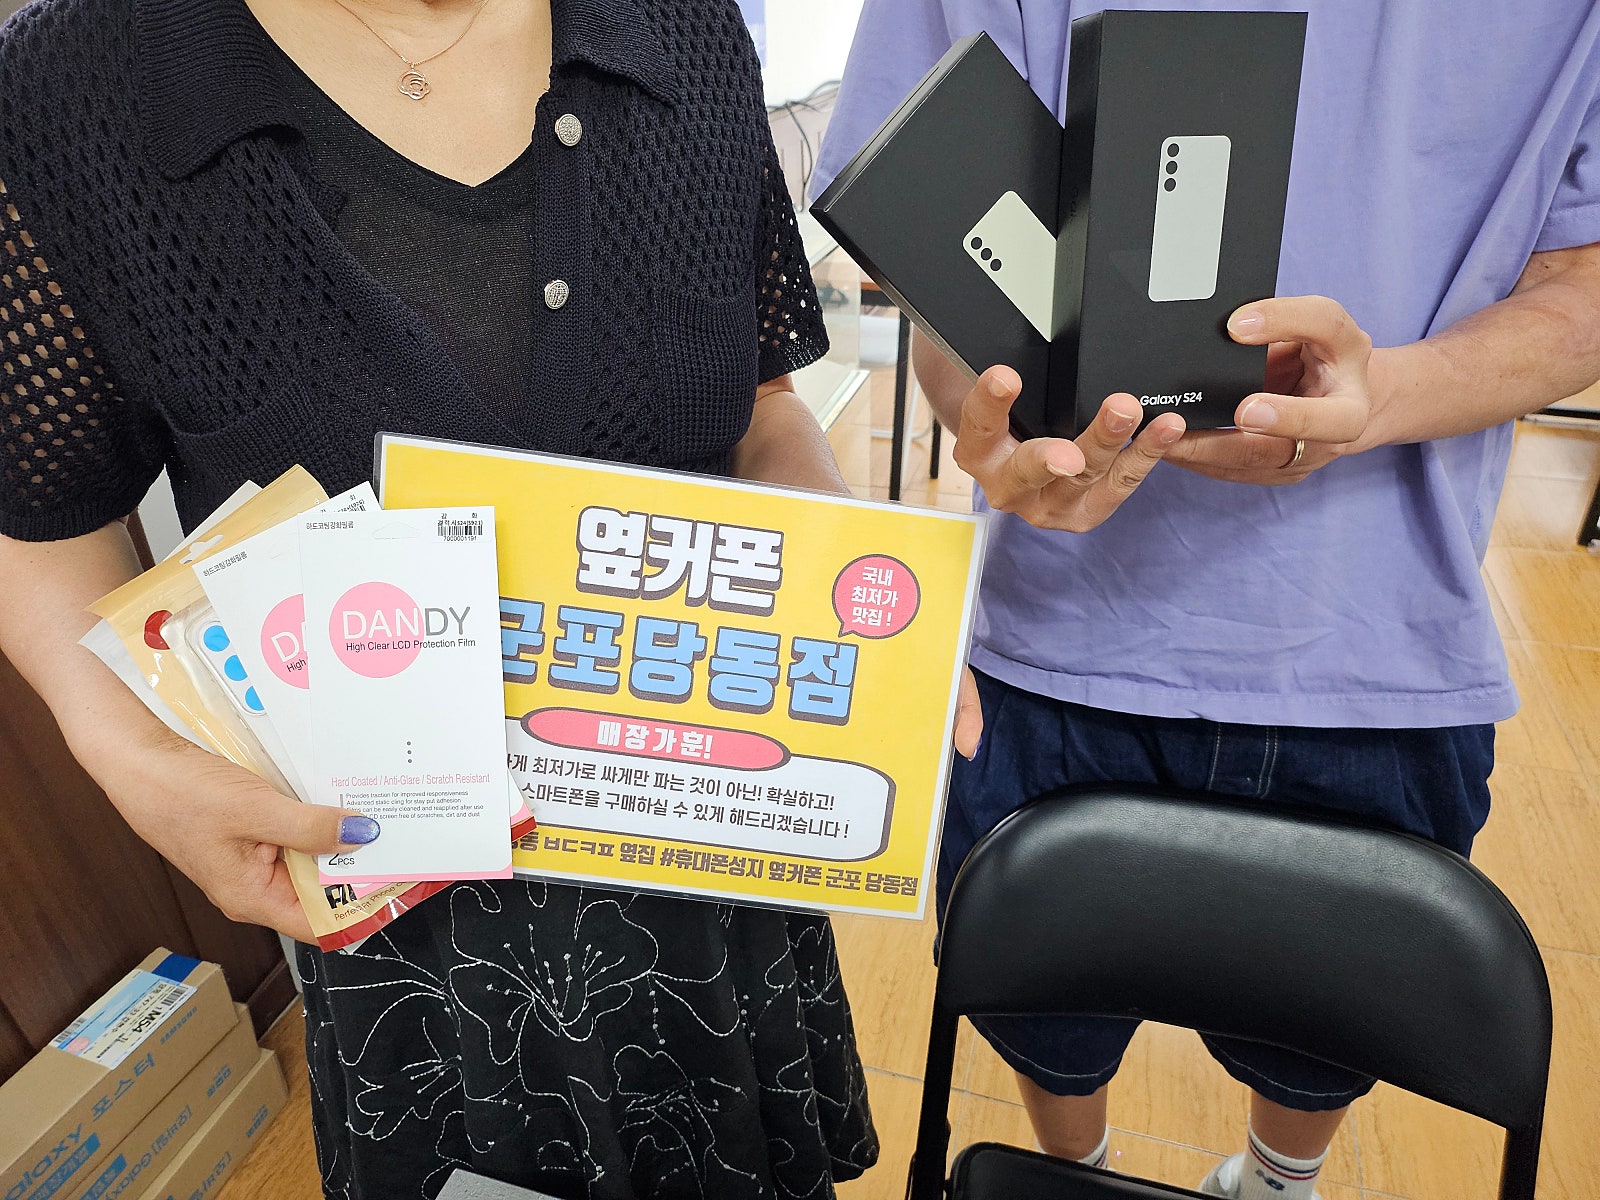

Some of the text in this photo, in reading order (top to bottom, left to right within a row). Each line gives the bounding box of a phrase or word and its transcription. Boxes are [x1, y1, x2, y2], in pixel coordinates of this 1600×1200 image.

[1140, 391, 1203, 406] Galaxy S24
[575, 505, 784, 617] 옆커폰
[862, 566, 894, 587] 국내
[851, 585, 899, 608] 최저가
[342, 606, 471, 640] DANDY
[851, 606, 883, 627] 맛집
[346, 638, 476, 653] High Clear LCD Protection Film
[286, 658, 307, 673] High
[331, 776, 350, 787] Hard
[351, 775, 378, 787] Coated
[383, 774, 420, 786] Anti-Glare
[426, 773, 454, 785] Scratch
[455, 773, 490, 784] Resistant
[532, 756, 597, 781] 최저가로
[600, 765, 650, 787] 싸게만
[653, 772, 685, 793] 파는
[689, 775, 721, 797] 것이
[726, 781, 762, 802] 아닌!
[766, 786, 835, 811] 확실하고!
[521, 782, 600, 808] 스마트폰을
[604, 791, 669, 817] 구매하실
[672, 802, 689, 819] 수
[693, 803, 725, 823] 있게
[543, 836, 615, 858] ㅂㄷㅋㅍ
[620, 842, 656, 866] 옆집
[659, 847, 764, 879] #휴대폰성지
[768, 861, 823, 886] 옆커폰
[825, 868, 862, 891] 군포
[865, 871, 919, 897] 당동점
[4, 1123, 83, 1200] alaxy
[91, 1052, 156, 1122] 포스터
